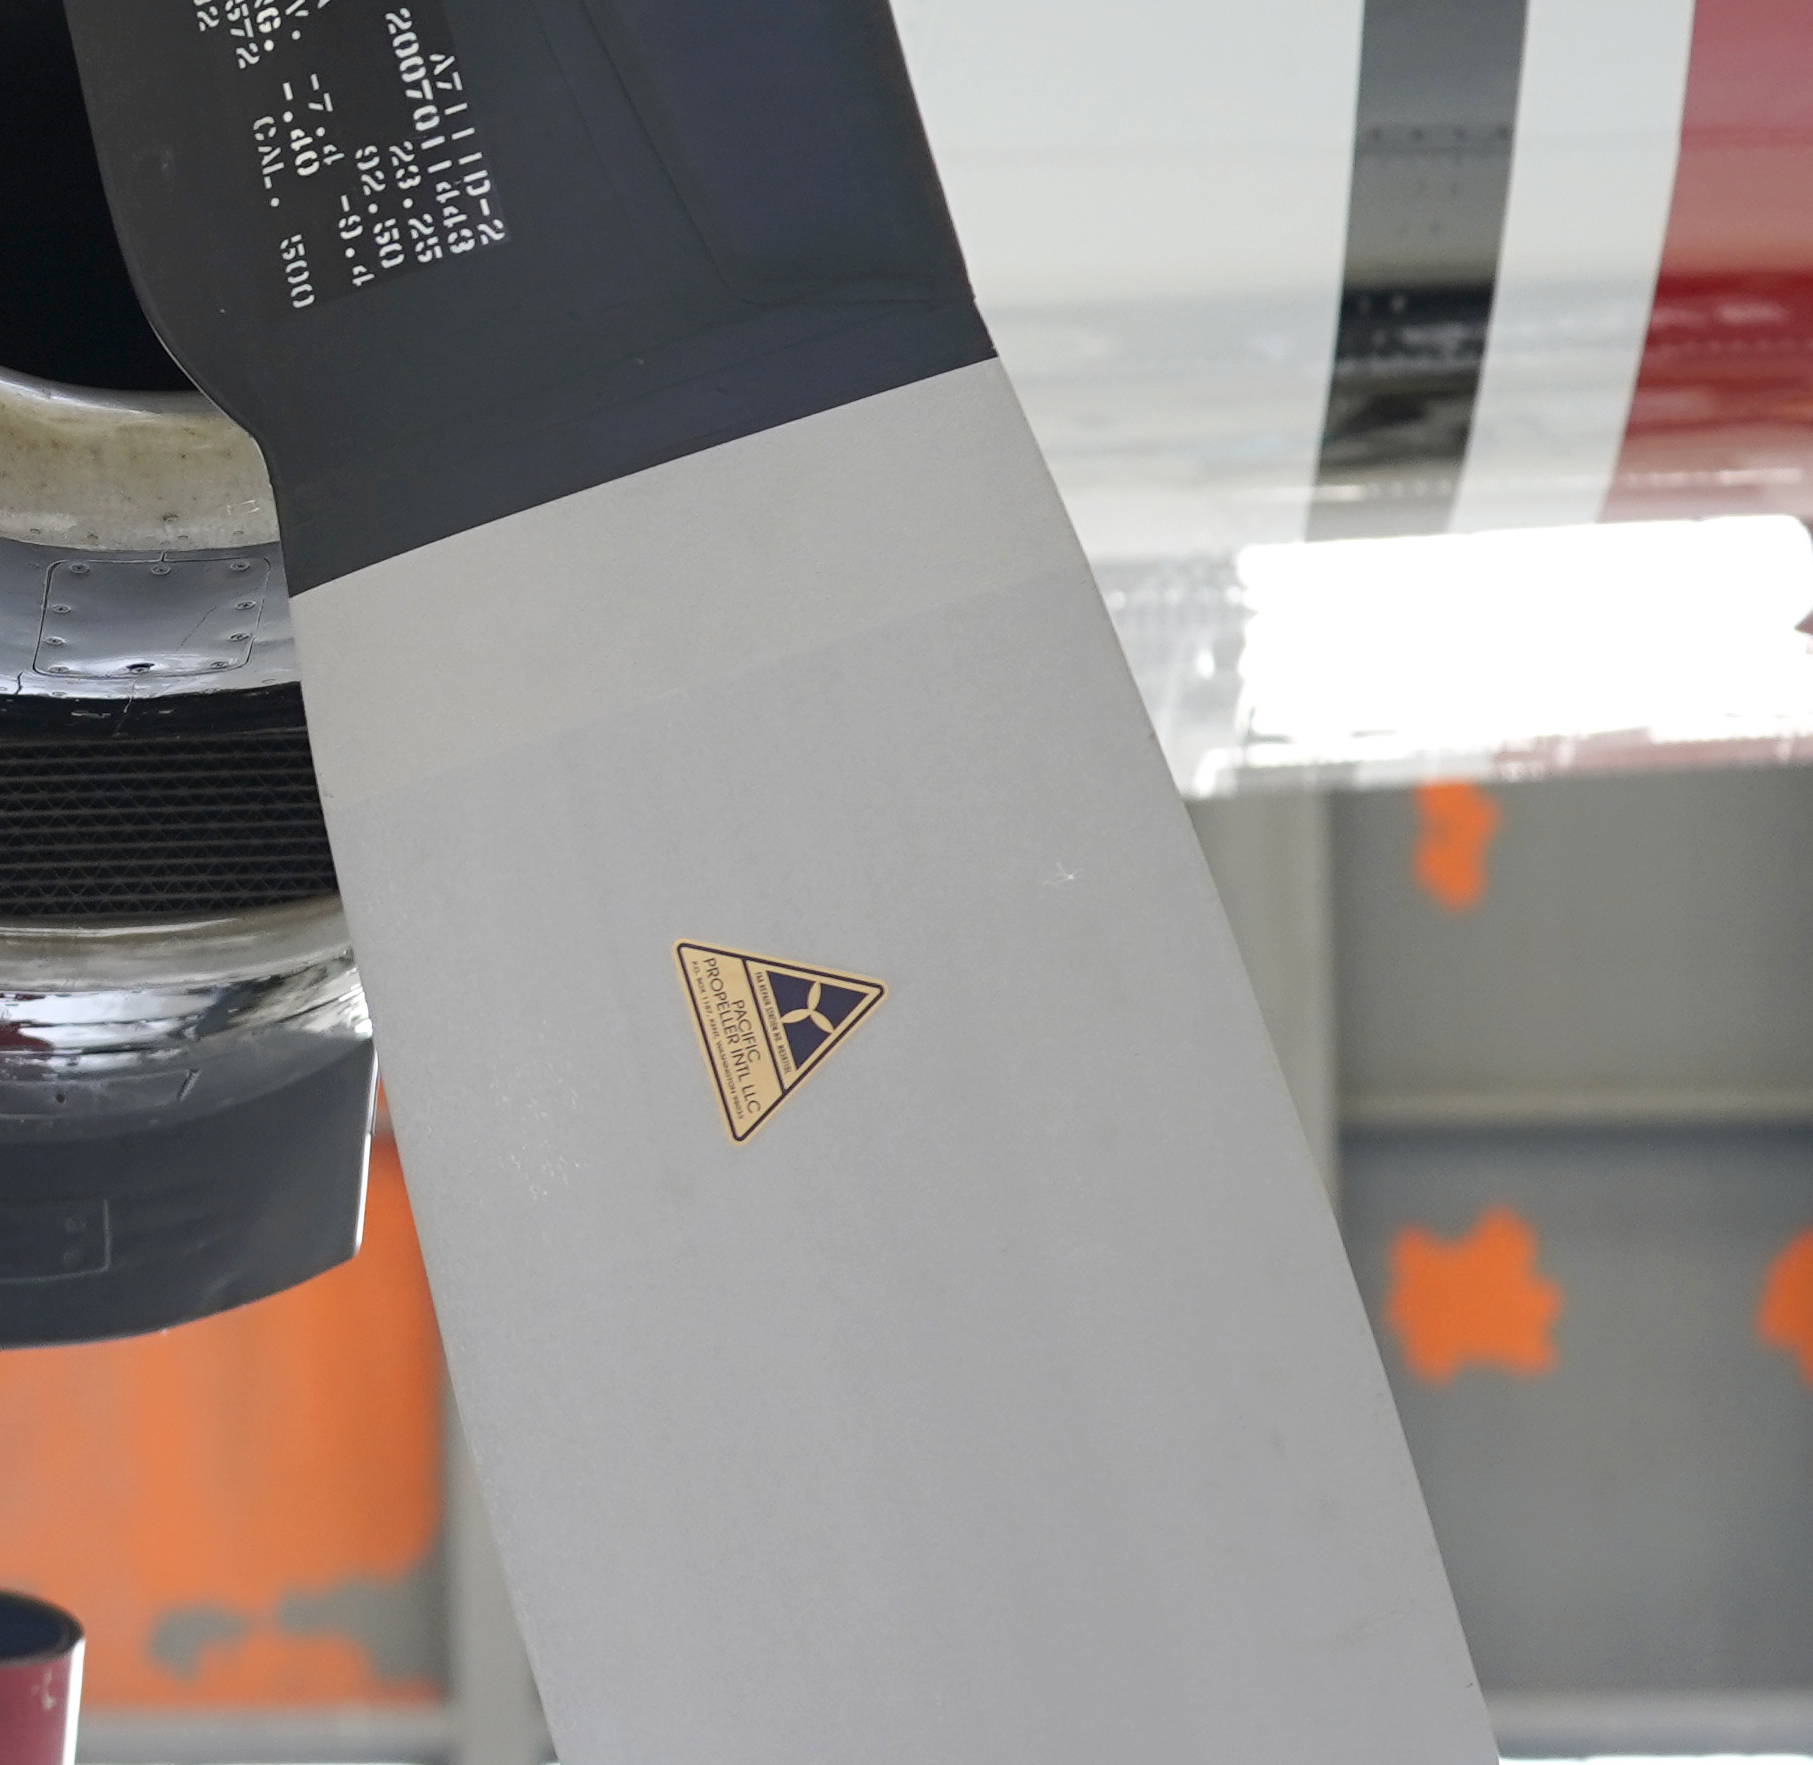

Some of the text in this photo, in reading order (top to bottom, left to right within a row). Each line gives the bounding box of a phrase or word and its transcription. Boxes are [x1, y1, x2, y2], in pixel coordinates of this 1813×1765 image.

[307, 73, 345, 166] -7.4
[338, 194, 375, 287] -9.4
[354, 145, 405, 269] 92.50
[385, 7, 476, 254] 2007011443
[388, 140, 443, 263] 23.25
[428, 53, 506, 246] A7111D-2
[252, 116, 285, 208] CAL.
[279, 234, 315, 309] 500
[696, 976, 706, 994] BOX
[716, 1041, 736, 1095] WASHINGTON
[704, 957, 760, 1114] PROPELLER INTL LLC
[731, 1000, 761, 1061] PACIFIC
